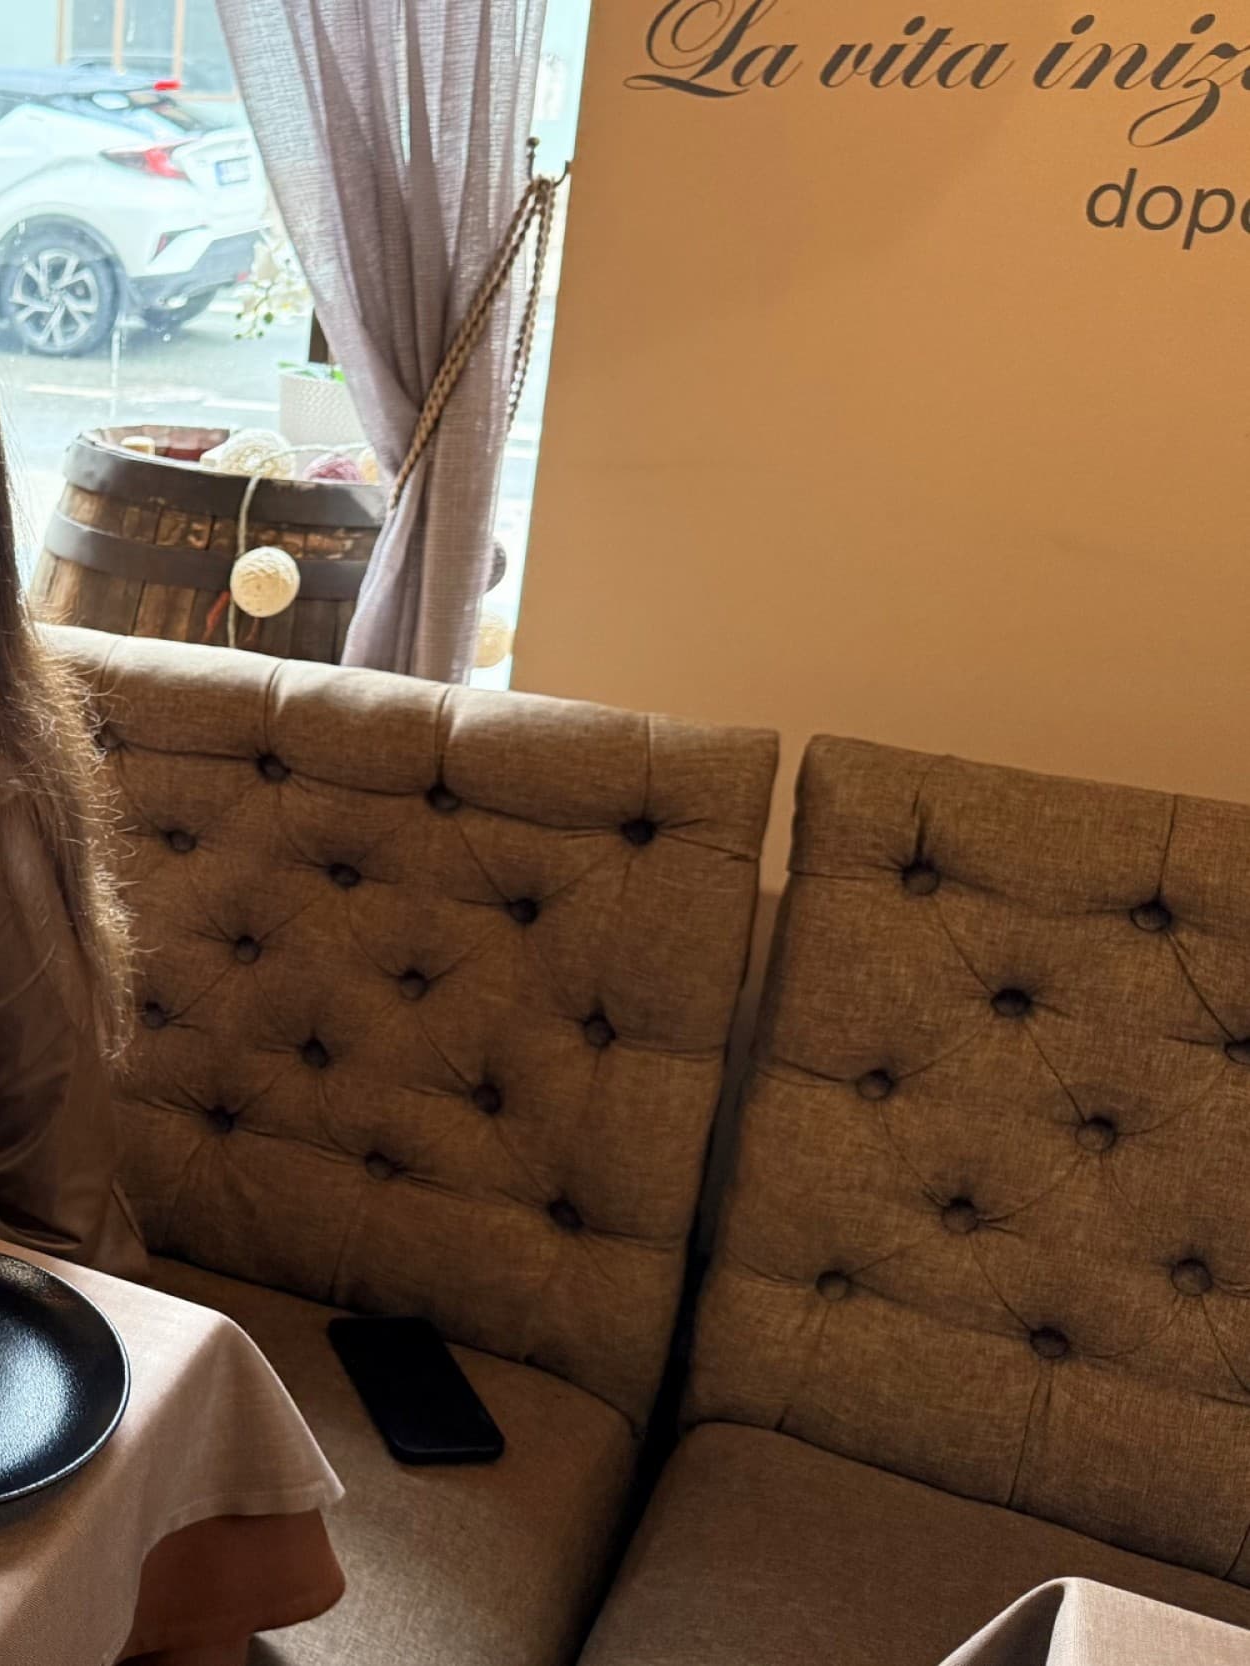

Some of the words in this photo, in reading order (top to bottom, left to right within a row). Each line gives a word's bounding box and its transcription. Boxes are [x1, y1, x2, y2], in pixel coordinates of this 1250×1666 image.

[622, 0, 804, 98] La
[819, 15, 1015, 90] vita
[1085, 167, 1250, 250] dop
